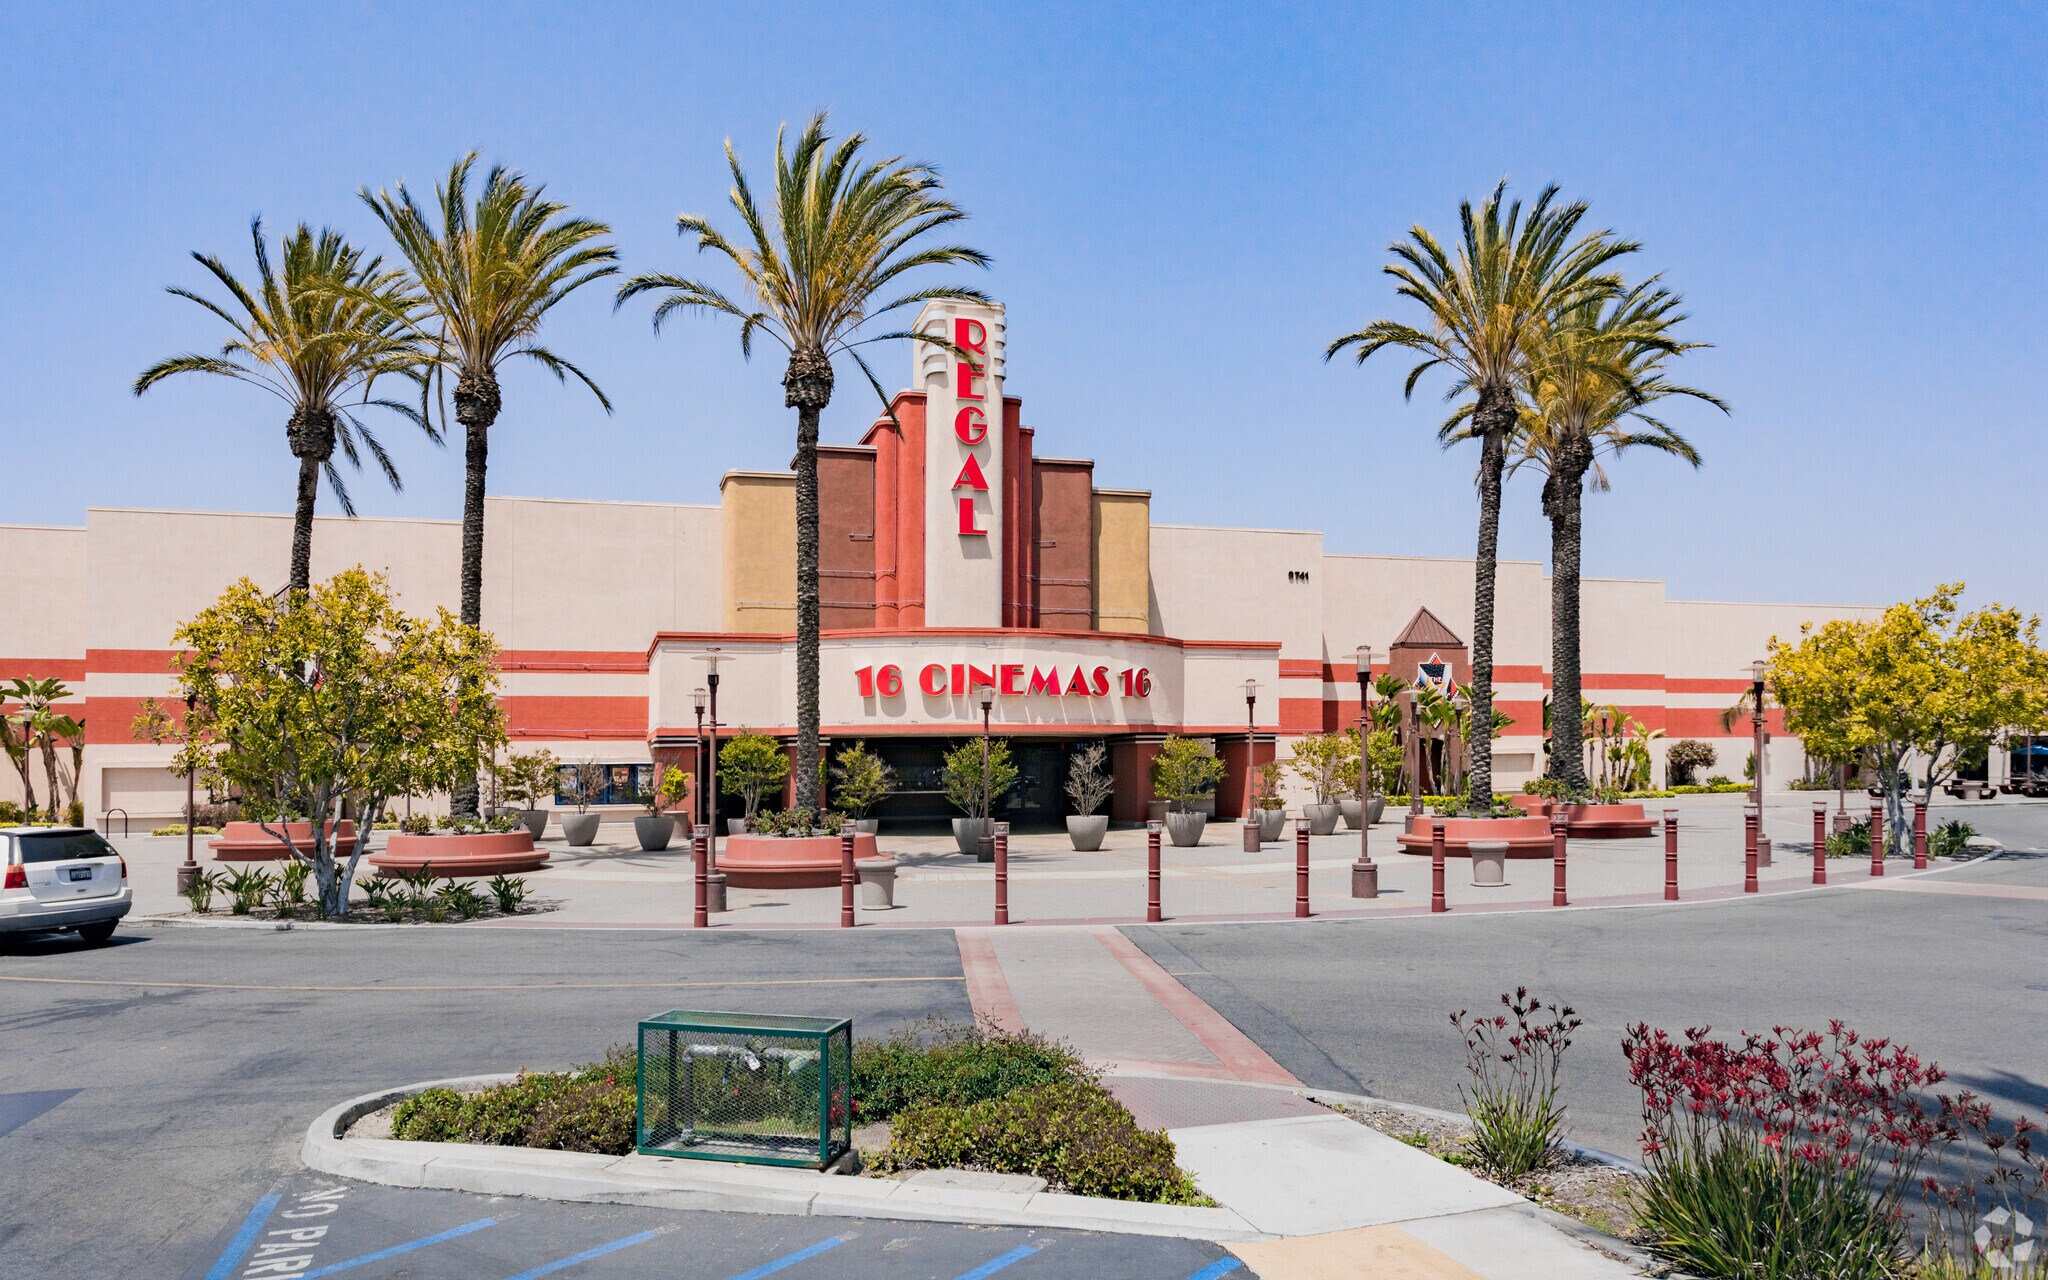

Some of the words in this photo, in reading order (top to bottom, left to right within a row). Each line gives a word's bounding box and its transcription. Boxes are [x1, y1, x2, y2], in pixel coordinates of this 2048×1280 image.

[952, 317, 990, 535] REGAL
[854, 663, 904, 698] 16
[918, 663, 1110, 698] CINEMAS
[1120, 666, 1152, 699] 16
[281, 1186, 349, 1219] NO
[240, 1225, 330, 1280] PAR
